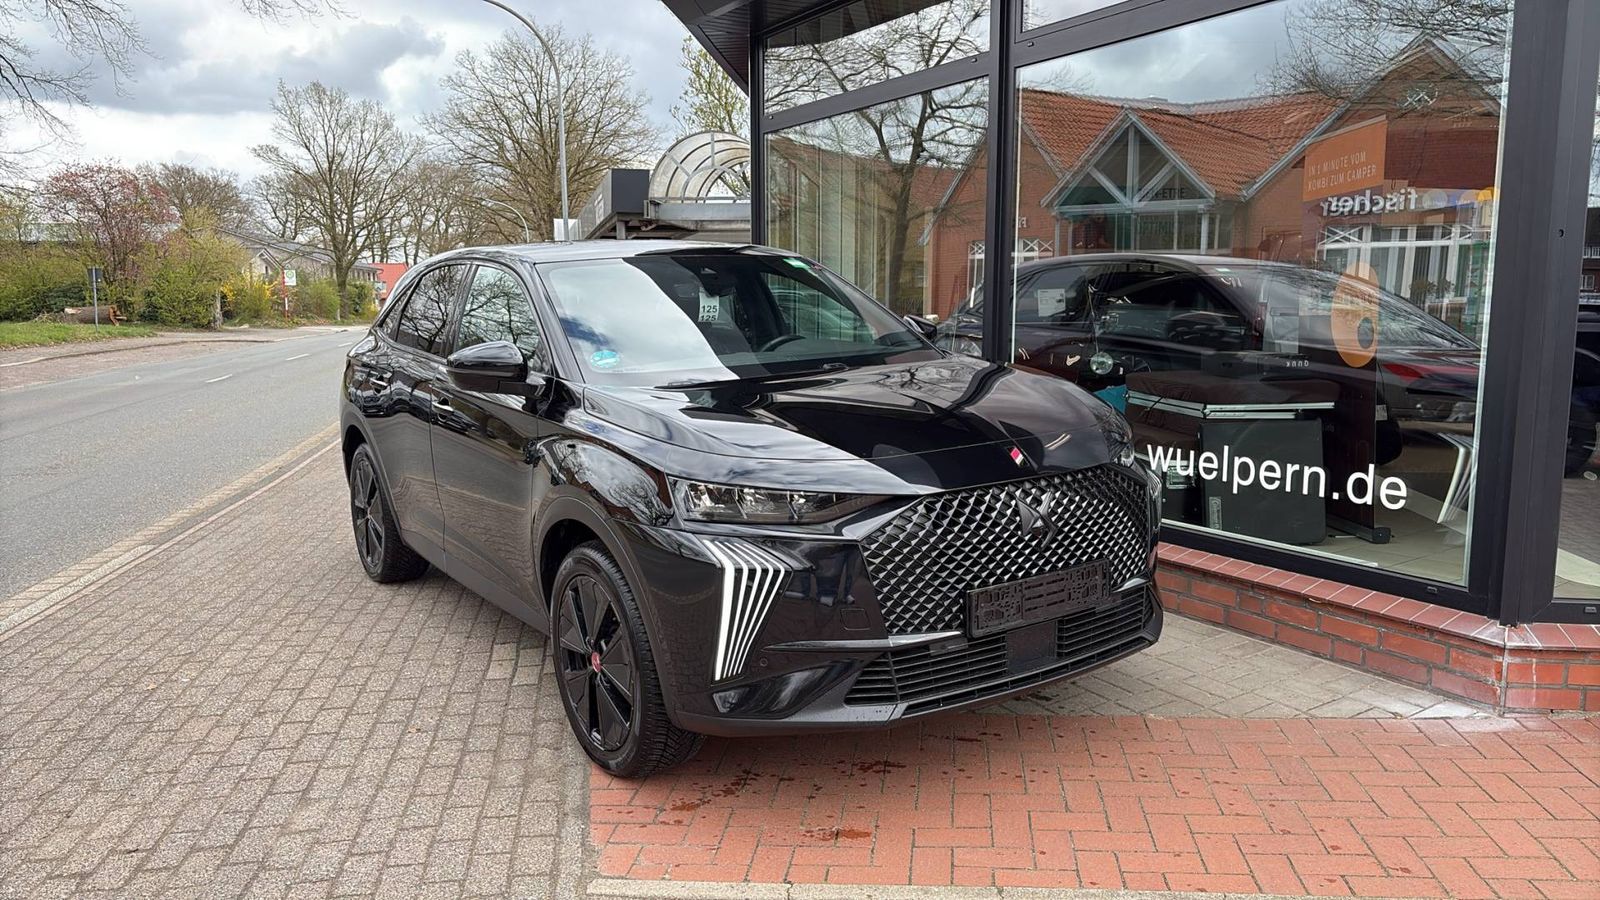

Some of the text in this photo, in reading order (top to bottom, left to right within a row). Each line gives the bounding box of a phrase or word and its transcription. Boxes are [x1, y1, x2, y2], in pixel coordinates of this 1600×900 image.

[1308, 166, 1315, 177] IN
[1323, 156, 1348, 172] MINUTE
[1351, 151, 1366, 165] VOM
[1308, 164, 1377, 192] KOMBI ZUM CAMPER
[700, 314, 717, 322] 125
[701, 304, 718, 313] 125
[1147, 444, 1408, 510] wuelpern.de
